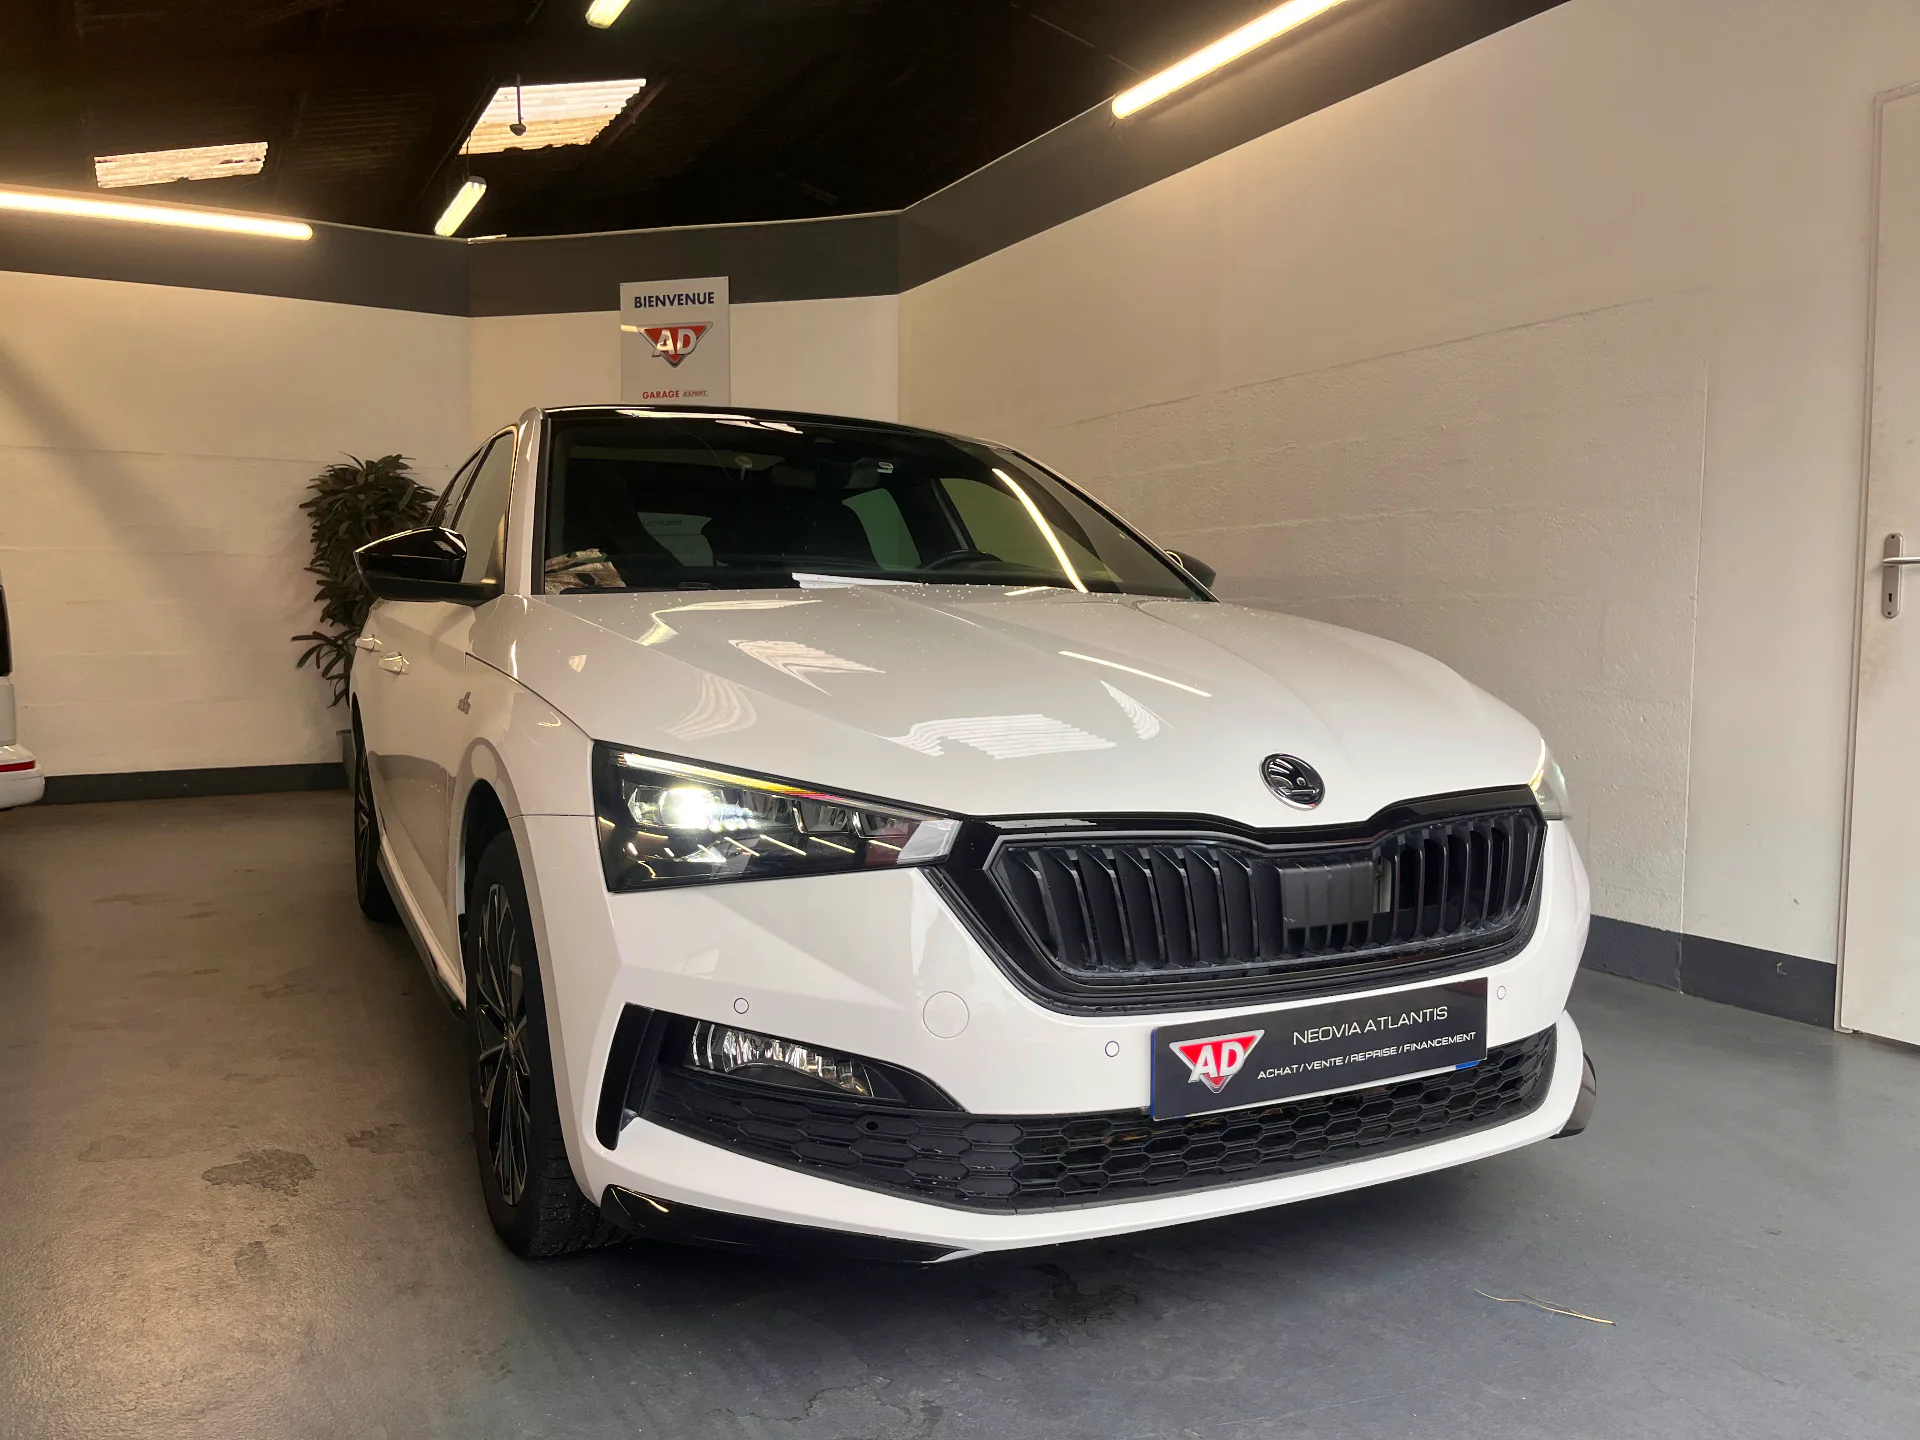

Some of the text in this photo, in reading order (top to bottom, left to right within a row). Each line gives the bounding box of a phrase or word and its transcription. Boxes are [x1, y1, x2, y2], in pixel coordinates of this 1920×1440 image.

[634, 291, 715, 309] BIENVENUE
[651, 328, 698, 358] AD
[642, 390, 680, 400] GARAGE
[1293, 1006, 1448, 1046] NEOVIA ATLANTIS
[1187, 1041, 1245, 1083] AD
[1257, 1064, 1299, 1080] ACHAT
[1305, 1056, 1344, 1071] VENTE
[1350, 1046, 1398, 1063] REPRISE
[1403, 1032, 1477, 1053] FINANCEMENT
